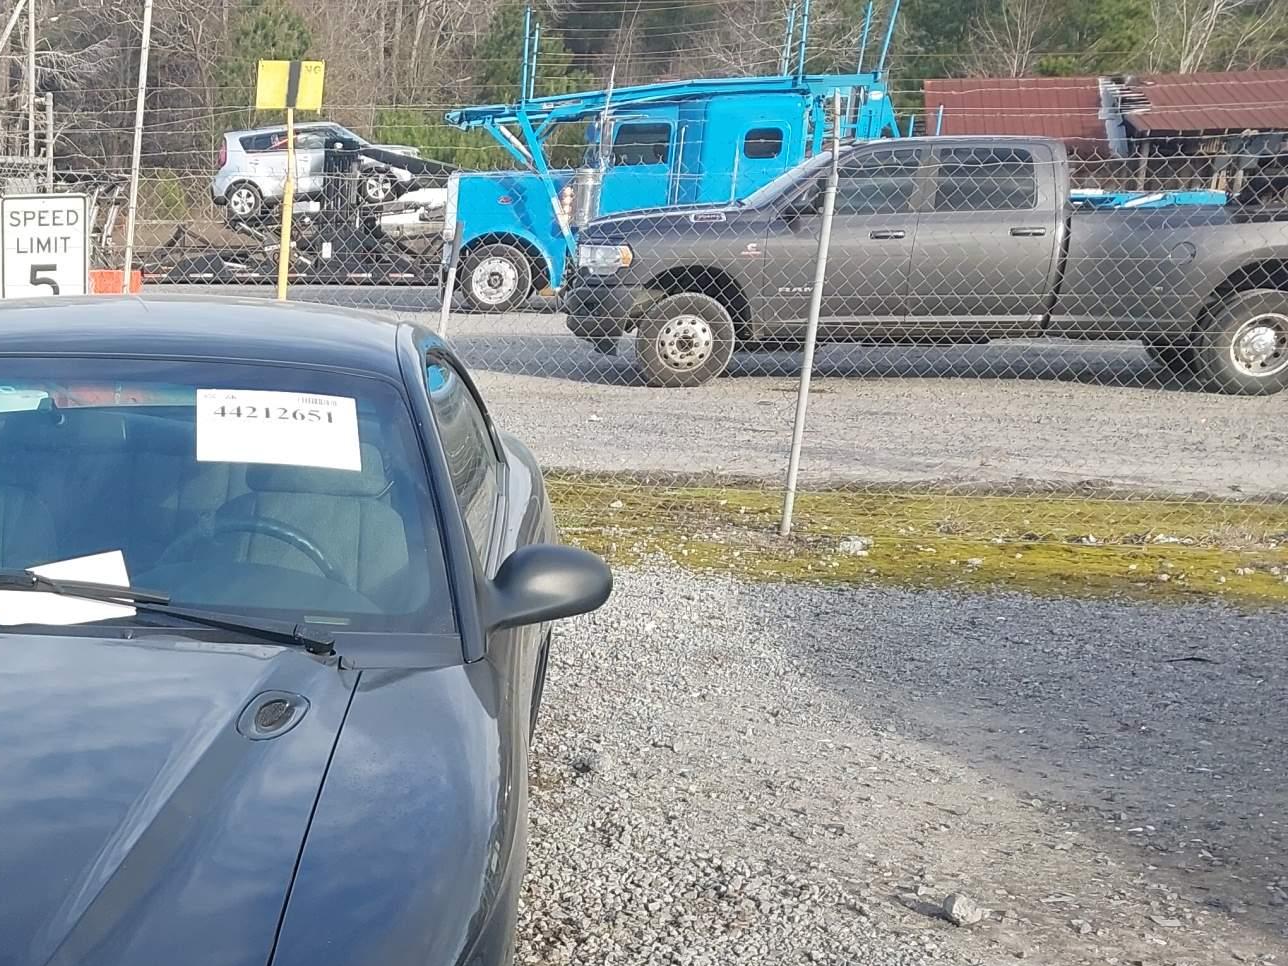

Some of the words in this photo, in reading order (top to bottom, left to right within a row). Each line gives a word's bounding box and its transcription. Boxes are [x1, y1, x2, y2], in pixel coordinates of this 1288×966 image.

[9, 209, 79, 227] SPEED
[16, 236, 71, 254] LIMIT
[29, 263, 60, 295] 5
[213, 405, 333, 424] 44212651
